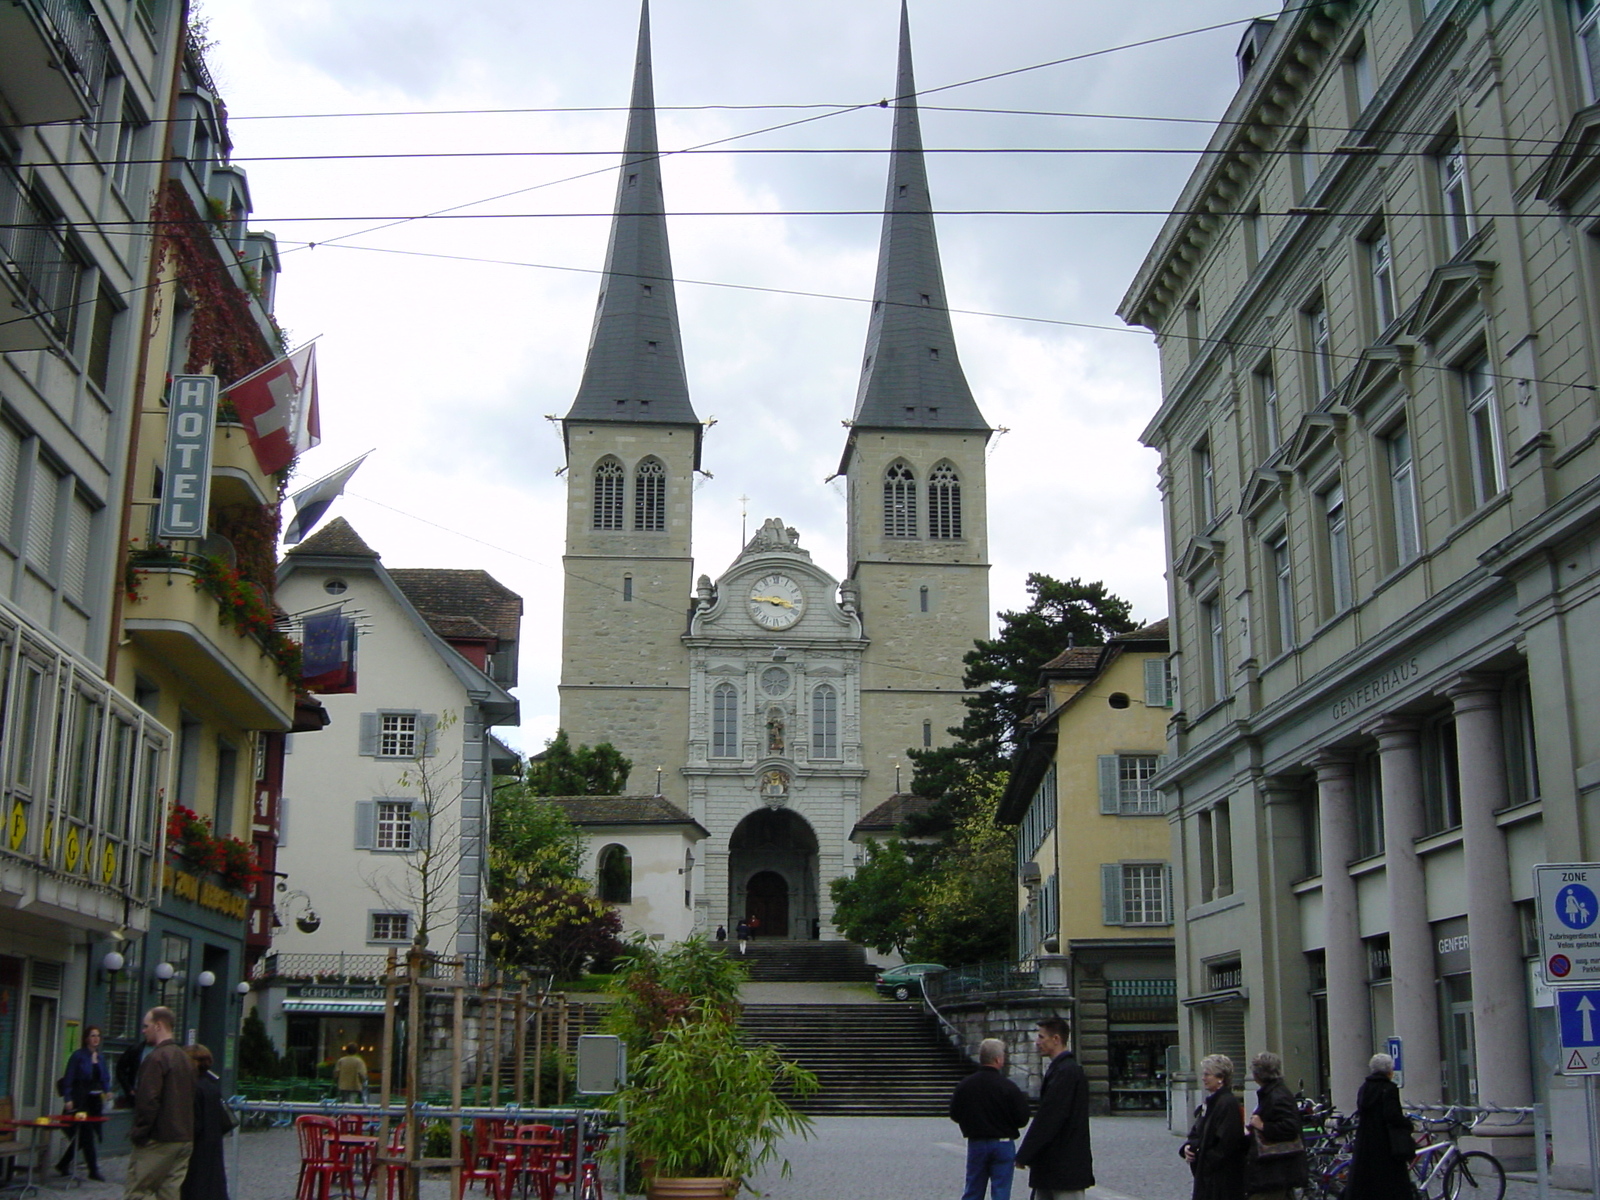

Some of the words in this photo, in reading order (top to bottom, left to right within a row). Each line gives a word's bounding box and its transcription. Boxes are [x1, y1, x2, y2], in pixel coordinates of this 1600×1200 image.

[170, 382, 205, 528] HOTEL
[1332, 656, 1419, 720] GENFERHAUS
[1562, 872, 1588, 882] ZONE
[1438, 934, 1469, 955] GENFER
[1549, 932, 1597, 941] Zubringerdienst
[1557, 941, 1575, 949] Velos
[1391, 1043, 1399, 1068] P
